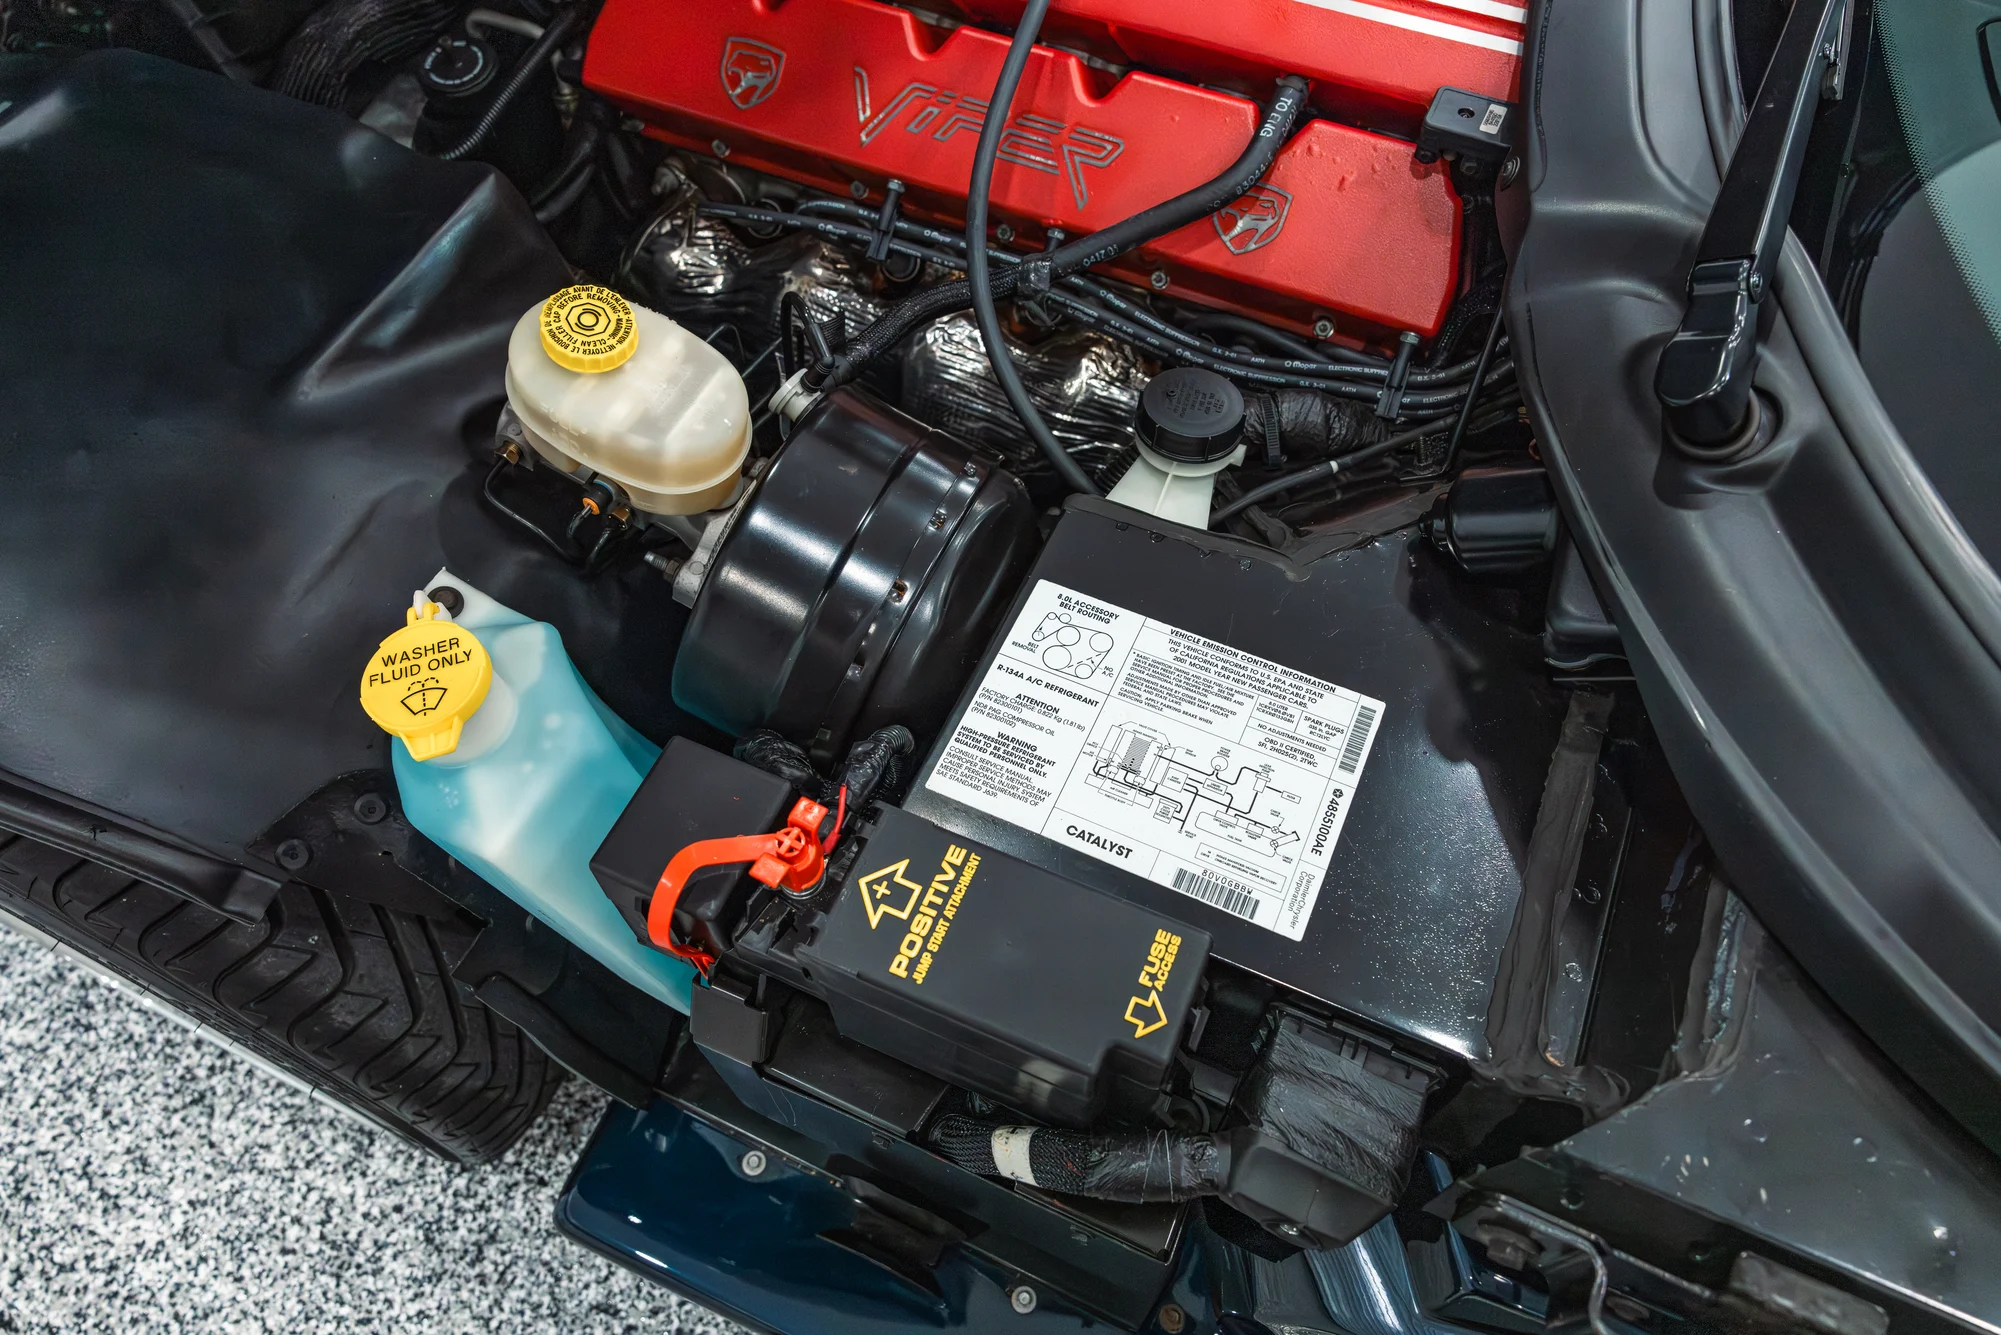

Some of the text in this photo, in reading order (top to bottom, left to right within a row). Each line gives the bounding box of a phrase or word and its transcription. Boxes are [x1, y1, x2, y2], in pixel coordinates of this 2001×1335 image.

[1275, 97, 1293, 112] TO
[854, 66, 1125, 211] VIPER
[546, 328, 570, 350] BOUCHON
[573, 285, 595, 294] AVANT
[596, 287, 605, 295] DE
[553, 310, 561, 324] CAP
[556, 293, 584, 310] BEFORE
[586, 293, 621, 315] REMOVING
[555, 325, 579, 345] FILLER
[580, 338, 607, 347] CLEAN
[1106, 293, 1127, 309] Mopar
[1134, 310, 1166, 331] ELECTRONIC
[1164, 327, 1200, 347] SUPPRESSION
[1293, 361, 1318, 370] Mopar
[1328, 364, 1363, 373] ELECTRONIC
[1213, 363, 1248, 377] ELECTRONIC
[1247, 372, 1286, 384] SUPPRESSION
[1057, 593, 1120, 620] 8.0L ACCESSORY
[1059, 601, 1111, 624] BELT ROUTING
[381, 637, 460, 668] WASHER
[1012, 641, 1036, 654] REMOVAL
[1027, 641, 1039, 649] BELT
[1170, 628, 1336, 693] VEHICLE EMISSION CONTROL INFORMATION
[369, 649, 473, 688] FLUID ONLY
[996, 664, 1100, 707] R-134A A/C REFRIGERANT
[1101, 670, 1114, 678] A/C
[1136, 653, 1151, 662] BASIC
[1151, 659, 1173, 670] IGNITION
[1173, 666, 1190, 676] TIMING
[1212, 681, 1234, 692] FUEL/AIR
[1234, 689, 1255, 700] MIXTURE
[1168, 638, 1182, 648] THIS
[1183, 644, 1209, 658] VEHICLE
[1209, 654, 1249, 672] CONFORMS
[1260, 672, 1272, 681] U.S.
[1273, 676, 1286, 686] EPA
[1287, 682, 1304, 692] AND
[1304, 688, 1324, 699] STATE
[1169, 646, 1317, 704] OF CALIFORNIA REGULATIONS APPLICABLE TO
[1172, 655, 1308, 709] 2001 MODEL YEAR NEW PASSENGER CARS.
[971, 706, 986, 715] (P/N
[978, 692, 993, 702] (P/N
[981, 687, 1010, 703] FACTORY
[1009, 698, 1035, 712] CHARGE:
[1037, 708, 1054, 718] 0.822
[1053, 715, 1063, 723] Kg
[1015, 693, 1060, 715] ATTENTION
[988, 706, 1002, 715] PAG
[1002, 711, 1045, 732] COMPRESSOR
[1045, 728, 1055, 736] OIL
[1303, 715, 1345, 735] SPARK PLUGS
[957, 731, 982, 745] SYSTEM
[982, 741, 992, 749] TO
[992, 745, 1002, 753] BE
[1001, 749, 1035, 766] SERVICED
[960, 725, 1056, 767] HIGH-PRESSURE REFRIGERANT
[997, 731, 1038, 752] WARNING
[1257, 741, 1268, 750] SFI,
[1300, 757, 1318, 768] 2TWC
[1264, 737, 1279, 746] OBD
[1284, 744, 1316, 761] CERTIFIED,
[1267, 727, 1305, 744] ADJUSTMENTS
[1305, 741, 1327, 752] NEEDED
[946, 751, 1052, 797] IMPROPER SERVICE METHODS MAY
[949, 745, 1032, 783] CONSULT SERVICE MANUAL.
[954, 737, 1047, 779] QUALIFIED PERSONNEL ONLY.
[936, 769, 998, 798] SAE STANDARD J639.
[939, 763, 1039, 807] MEETS SAFETY REQUIREMENTS OF
[943, 757, 1045, 803] CAUSE PERSONAL INJURY. SYSTEM
[1066, 825, 1133, 859] CATALYST
[1310, 797, 1340, 857] 4855100AE
[1288, 871, 1308, 913] Corporation
[1290, 873, 1315, 929] DaimlerChrysler
[888, 844, 968, 979] POSITIVE
[911, 852, 982, 985] JUMP START ATTACHMENT
[1138, 928, 1172, 988] FUSE
[1153, 934, 1182, 992] ACCESS
